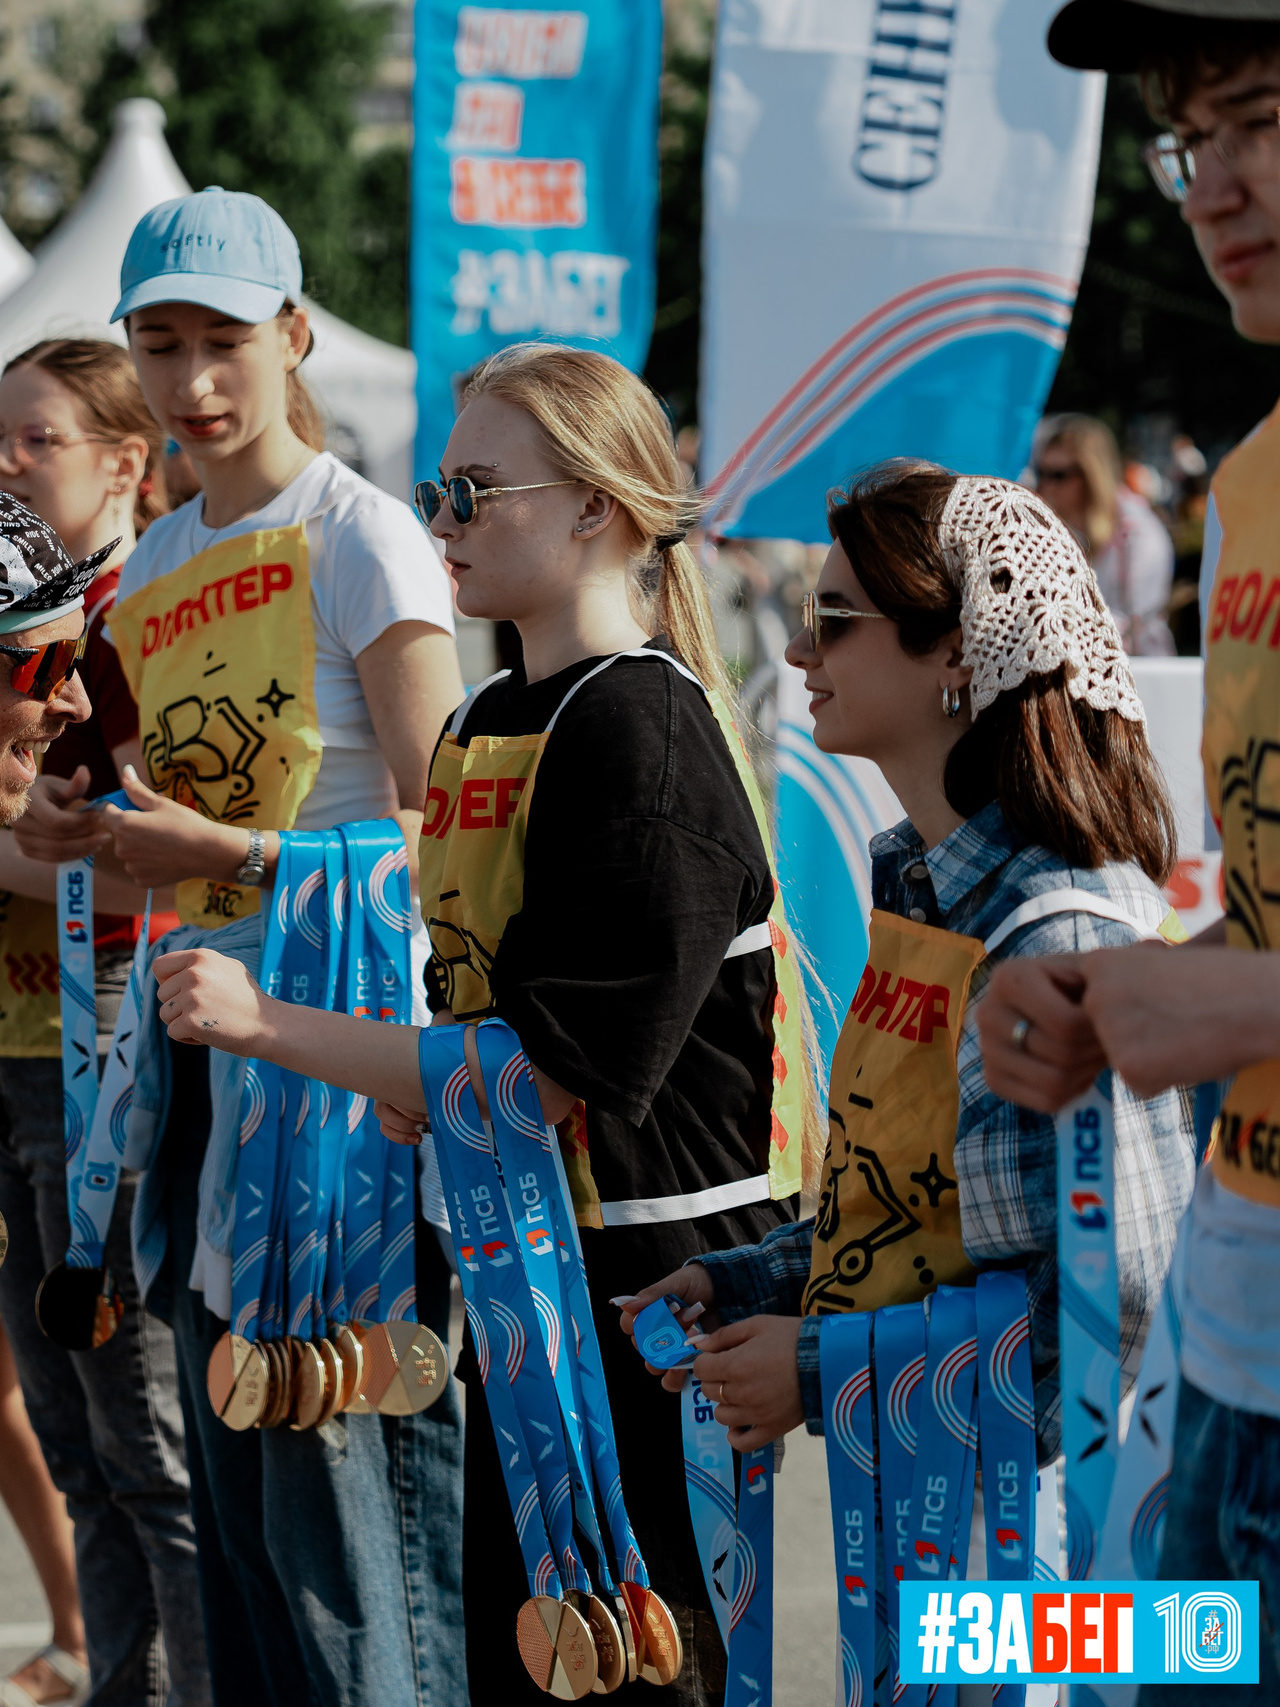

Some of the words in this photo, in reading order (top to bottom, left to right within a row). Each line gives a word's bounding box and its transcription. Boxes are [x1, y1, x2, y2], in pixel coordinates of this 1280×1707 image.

[851, 0, 958, 190] СЕН
[67, 870, 85, 915] ПСБ
[292, 974, 309, 1002] СБ
[1074, 1107, 1101, 1181] ПСБ
[470, 1184, 501, 1236] ПСБ
[518, 1172, 545, 1224] ПСБ
[921, 1474, 949, 1536] ПСБ
[997, 1459, 1020, 1521] ПСБ
[844, 1508, 865, 1569] ПСБ
